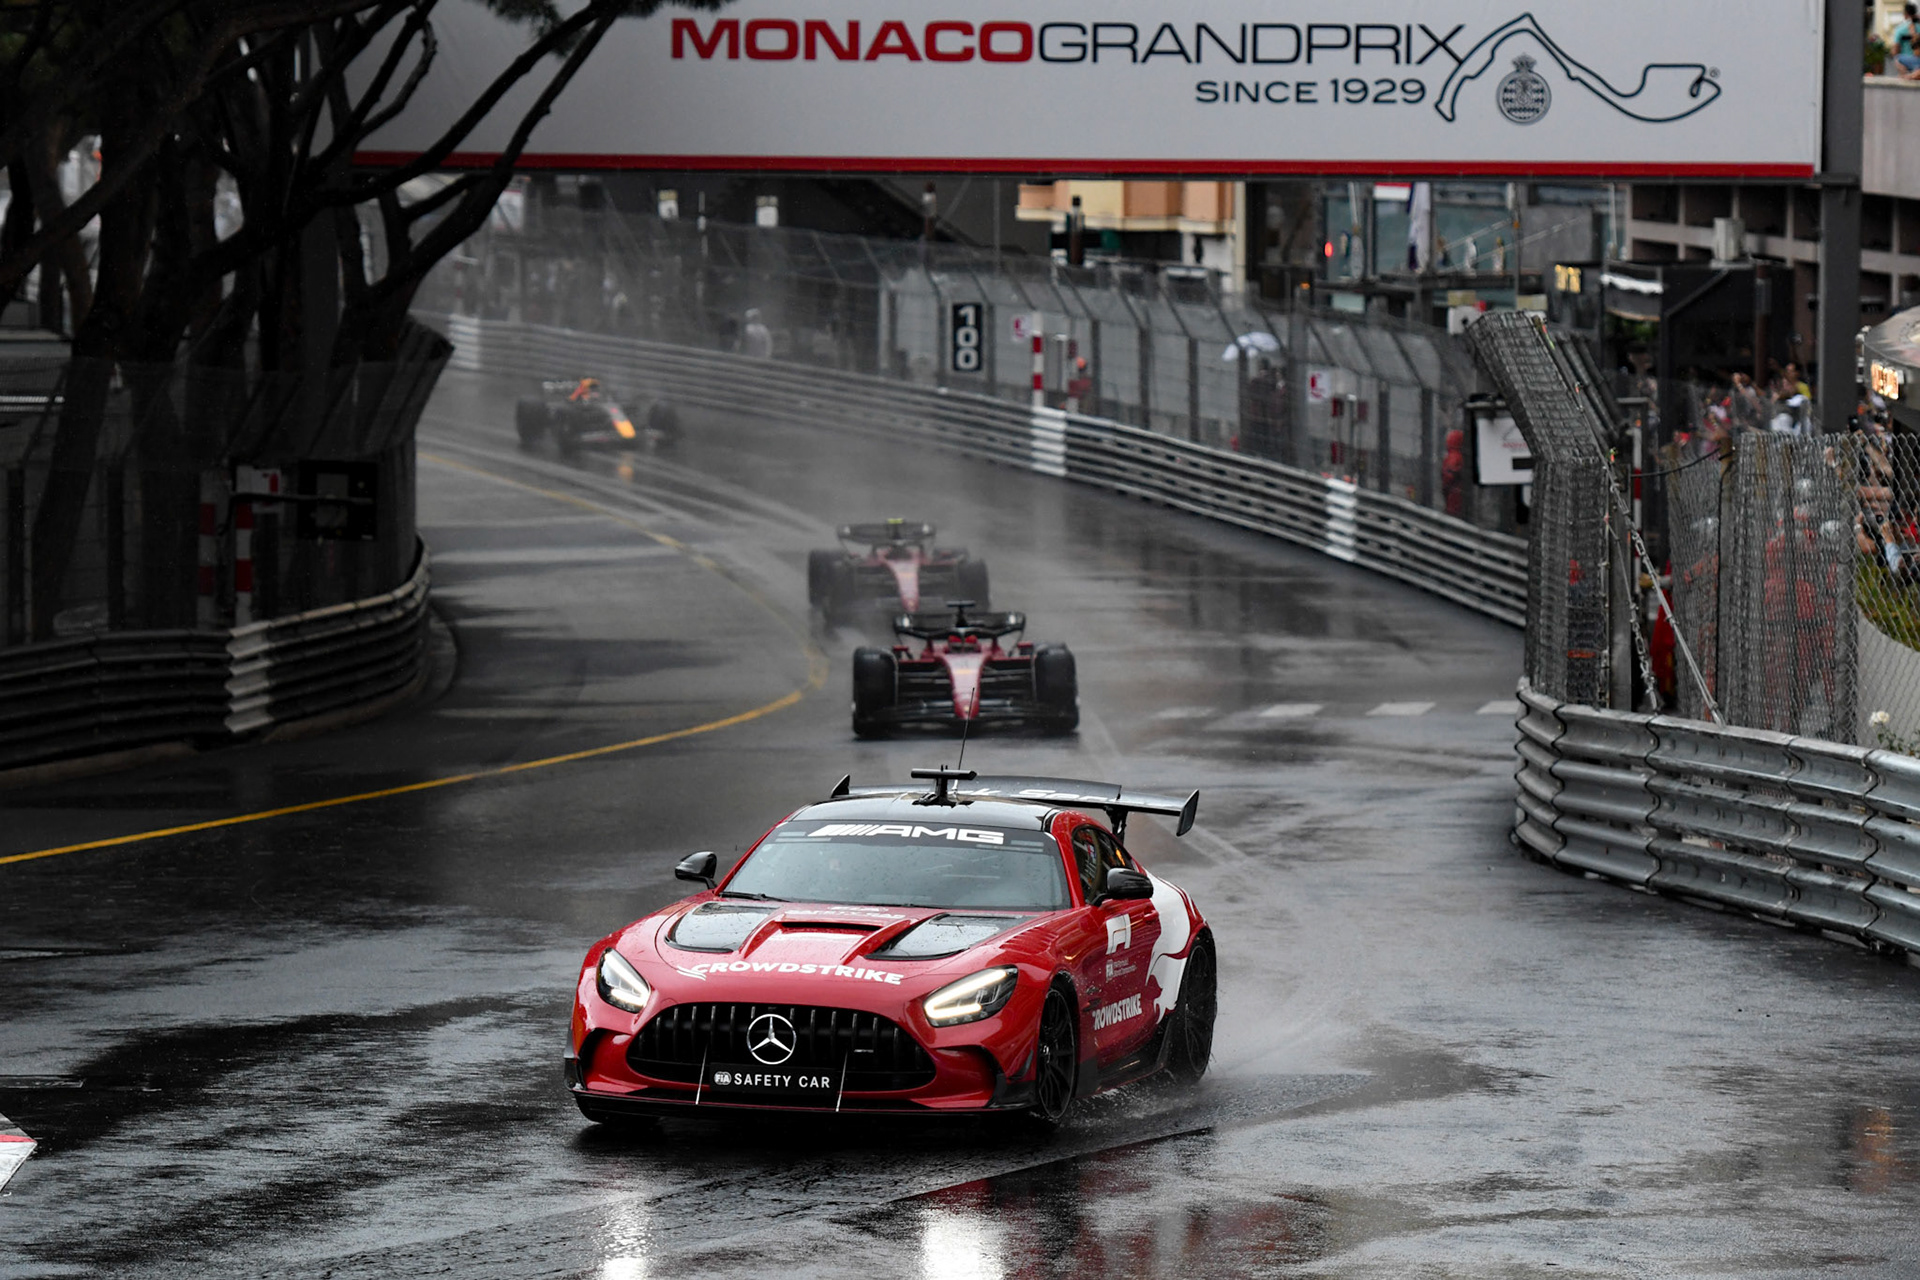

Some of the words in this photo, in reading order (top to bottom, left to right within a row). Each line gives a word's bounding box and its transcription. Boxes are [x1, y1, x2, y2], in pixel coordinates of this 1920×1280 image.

[1195, 80, 1318, 104] SINCE
[1331, 78, 1426, 104] 1929
[957, 305, 979, 370] 100
[865, 824, 1005, 845] AMG
[691, 960, 904, 985] CROWDSTRIKE
[734, 1073, 792, 1088] SAFETY
[798, 1076, 831, 1089] CAR
